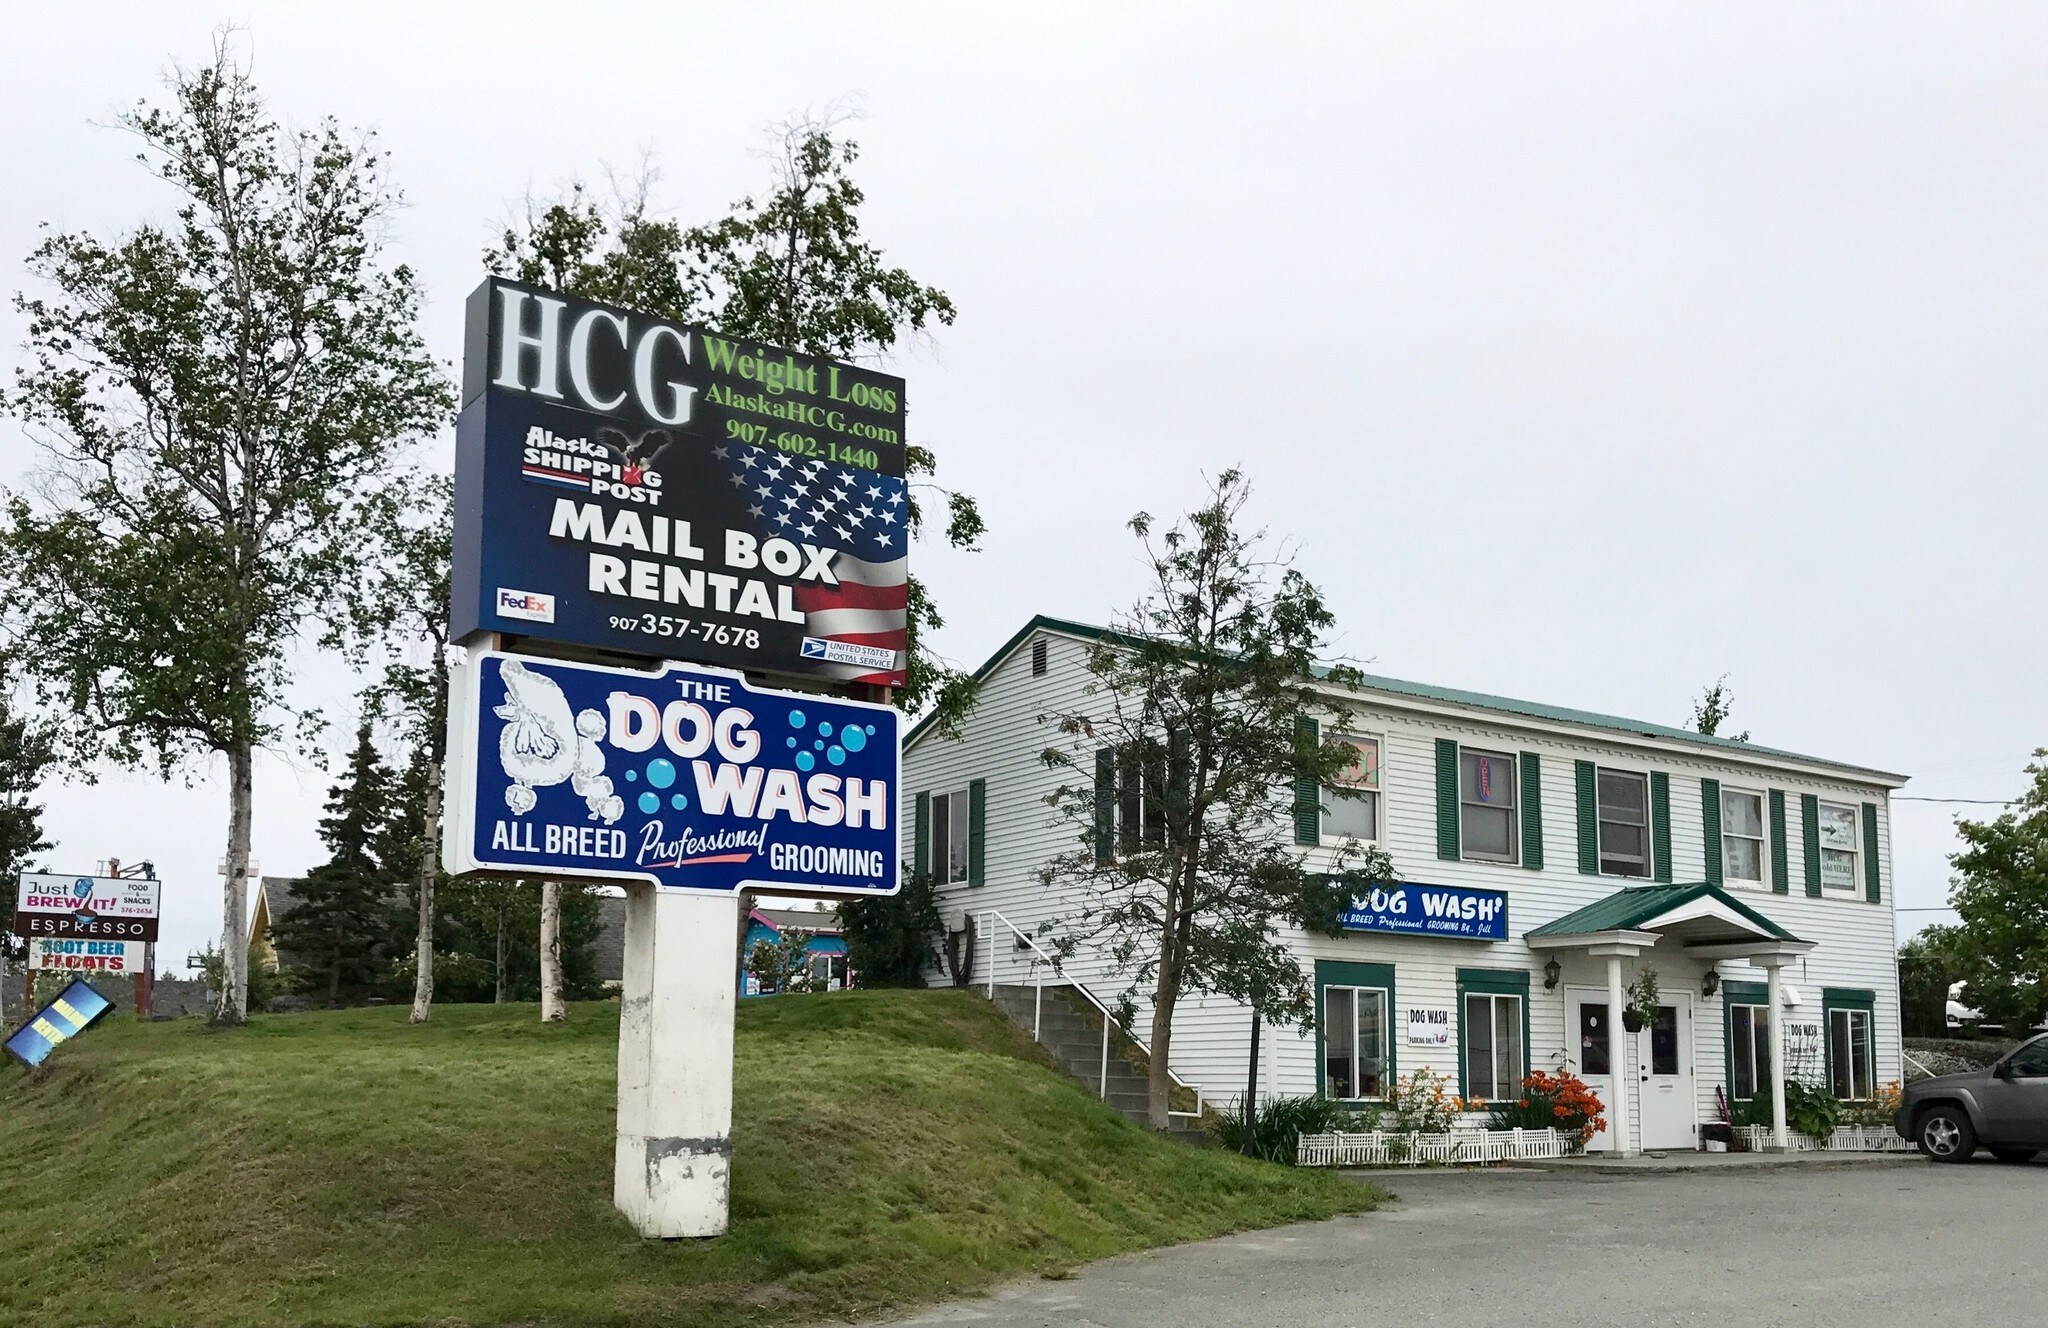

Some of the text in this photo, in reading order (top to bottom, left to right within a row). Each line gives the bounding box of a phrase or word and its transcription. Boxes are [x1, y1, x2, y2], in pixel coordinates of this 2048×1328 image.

[493, 286, 698, 425] HCG
[701, 334, 897, 414] Weight Loss
[704, 383, 898, 444] AlaskaHCG.com
[525, 425, 609, 459] Alaska
[725, 419, 879, 470] 907-602-1440
[523, 447, 662, 487] SHIPPIG
[591, 478, 662, 506] POST
[548, 498, 840, 586] MAIL BOX
[500, 592, 546, 612] FedEx
[588, 552, 805, 625] RENTAL
[608, 613, 760, 650] 907 357-7678
[828, 652, 892, 668] POSTAL SERVICE
[830, 643, 889, 658] UNITED STATES
[676, 679, 732, 704] THE
[606, 691, 760, 764] DOG
[1480, 757, 1490, 798] OPEN
[692, 760, 887, 831] WASH
[492, 818, 884, 878] ALL BREED Professional GROOMING
[28, 881, 69, 895] Just
[123, 897, 151, 905] SNACKS
[27, 895, 117, 911] BREW IT!
[1421, 893, 1493, 921] WASH
[31, 919, 144, 935] ESPRESSO
[1350, 913, 1374, 924] BREED
[1379, 915, 1424, 930] Professional
[1427, 920, 1459, 931] GROOMING
[1477, 924, 1492, 935] Jill
[41, 954, 124, 970] FLOATS
[87, 941, 125, 955] BEER
[1410, 1009, 1448, 1025] DOG WASH
[1790, 1023, 1818, 1037] DOG WASH
